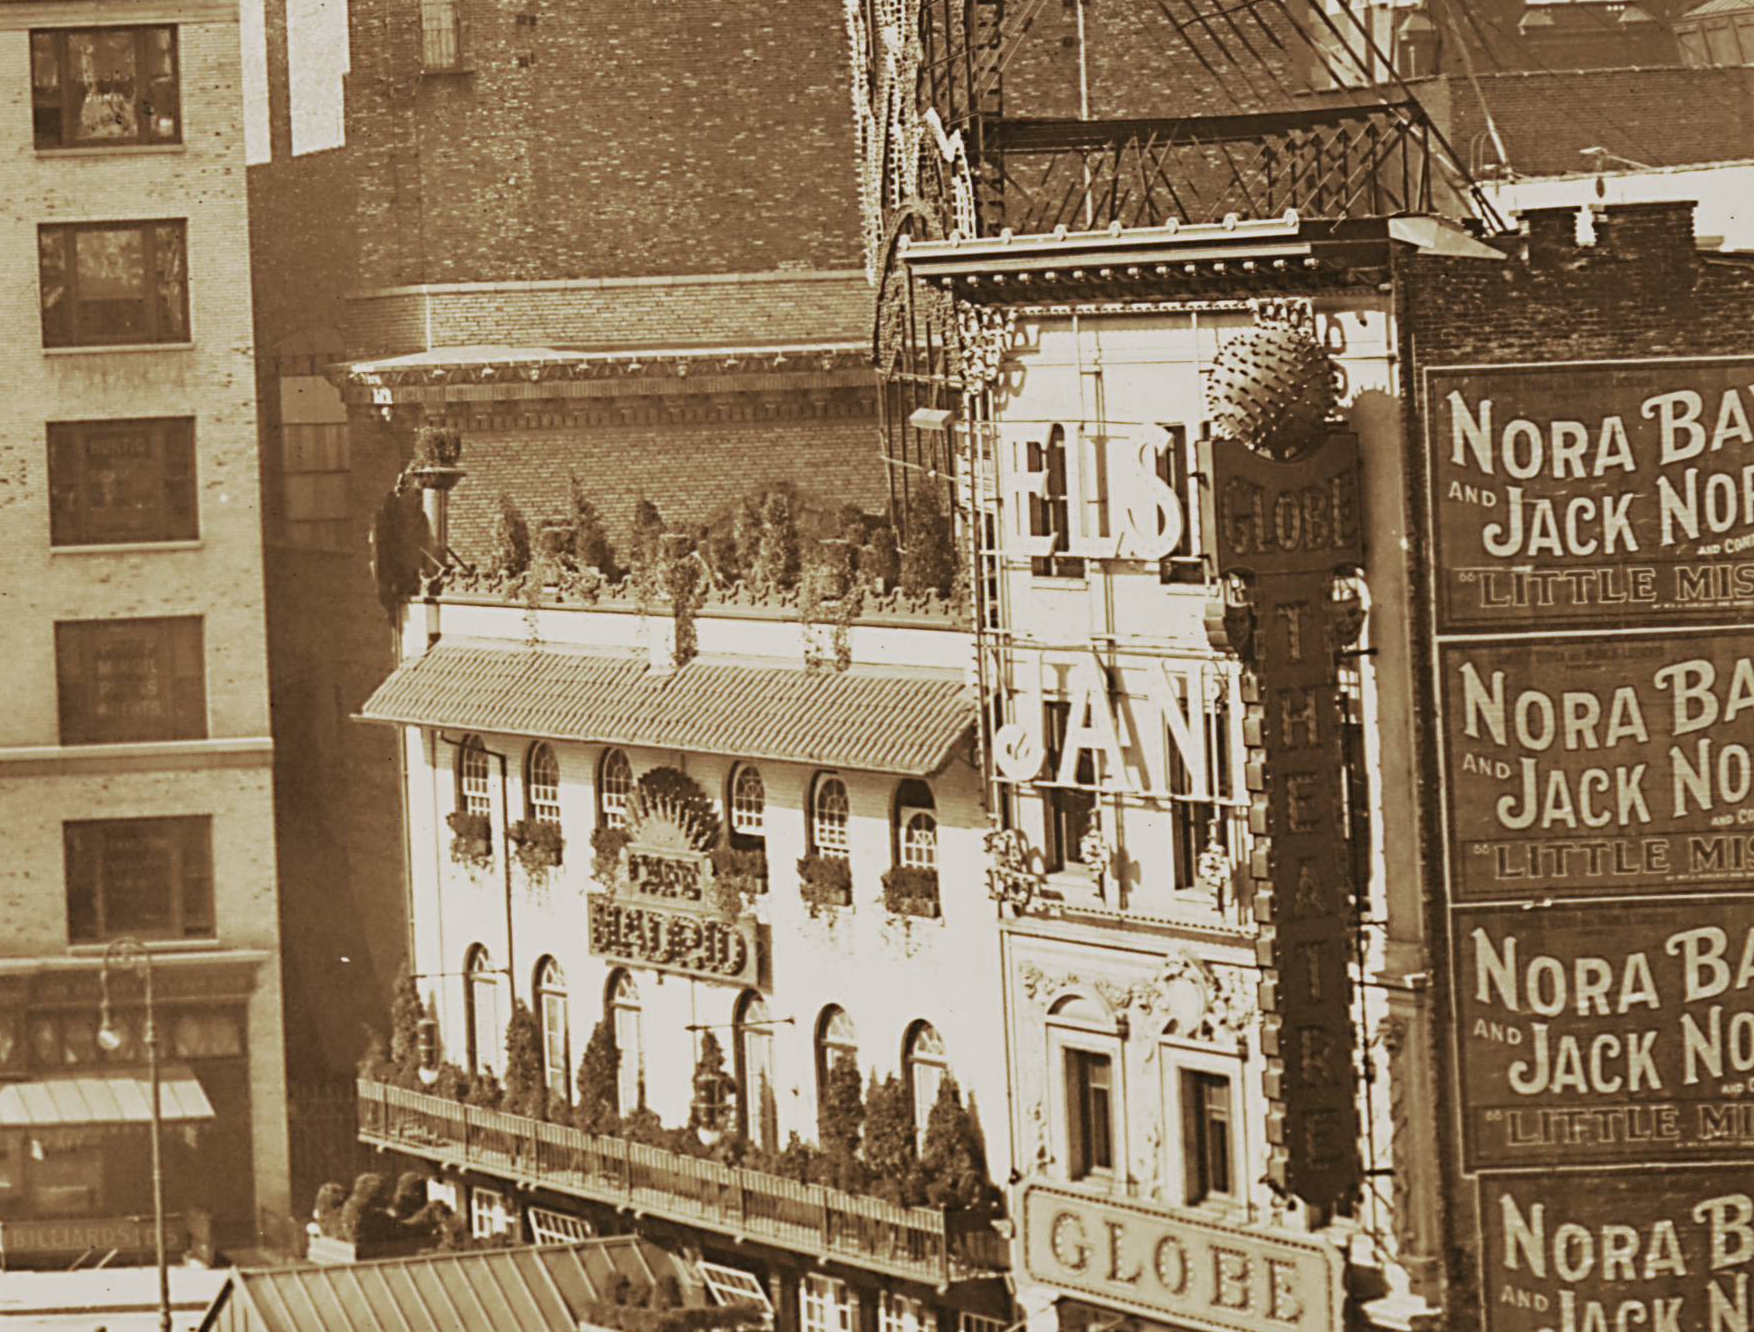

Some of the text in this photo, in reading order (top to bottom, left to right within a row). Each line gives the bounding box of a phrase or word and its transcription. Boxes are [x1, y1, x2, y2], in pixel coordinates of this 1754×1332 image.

[1445, 383, 1754, 481] NORA BA
[1223, 474, 1360, 556] GLOBE
[1448, 480, 1498, 508] AND
[1482, 485, 1640, 558] JACK
[1458, 661, 1651, 752] NORA
[1462, 752, 1512, 780] AND
[1497, 757, 1652, 830] JACK
[1470, 926, 1661, 1018] NORA
[1473, 1018, 1523, 1046] AND
[1507, 1021, 1663, 1095] JACK
[11, 1225, 132, 1249] BILLIARDS
[1050, 1209, 1304, 1327] GLOBE
[1498, 1193, 1688, 1284] NORA
[1500, 1284, 1550, 1313] AND
